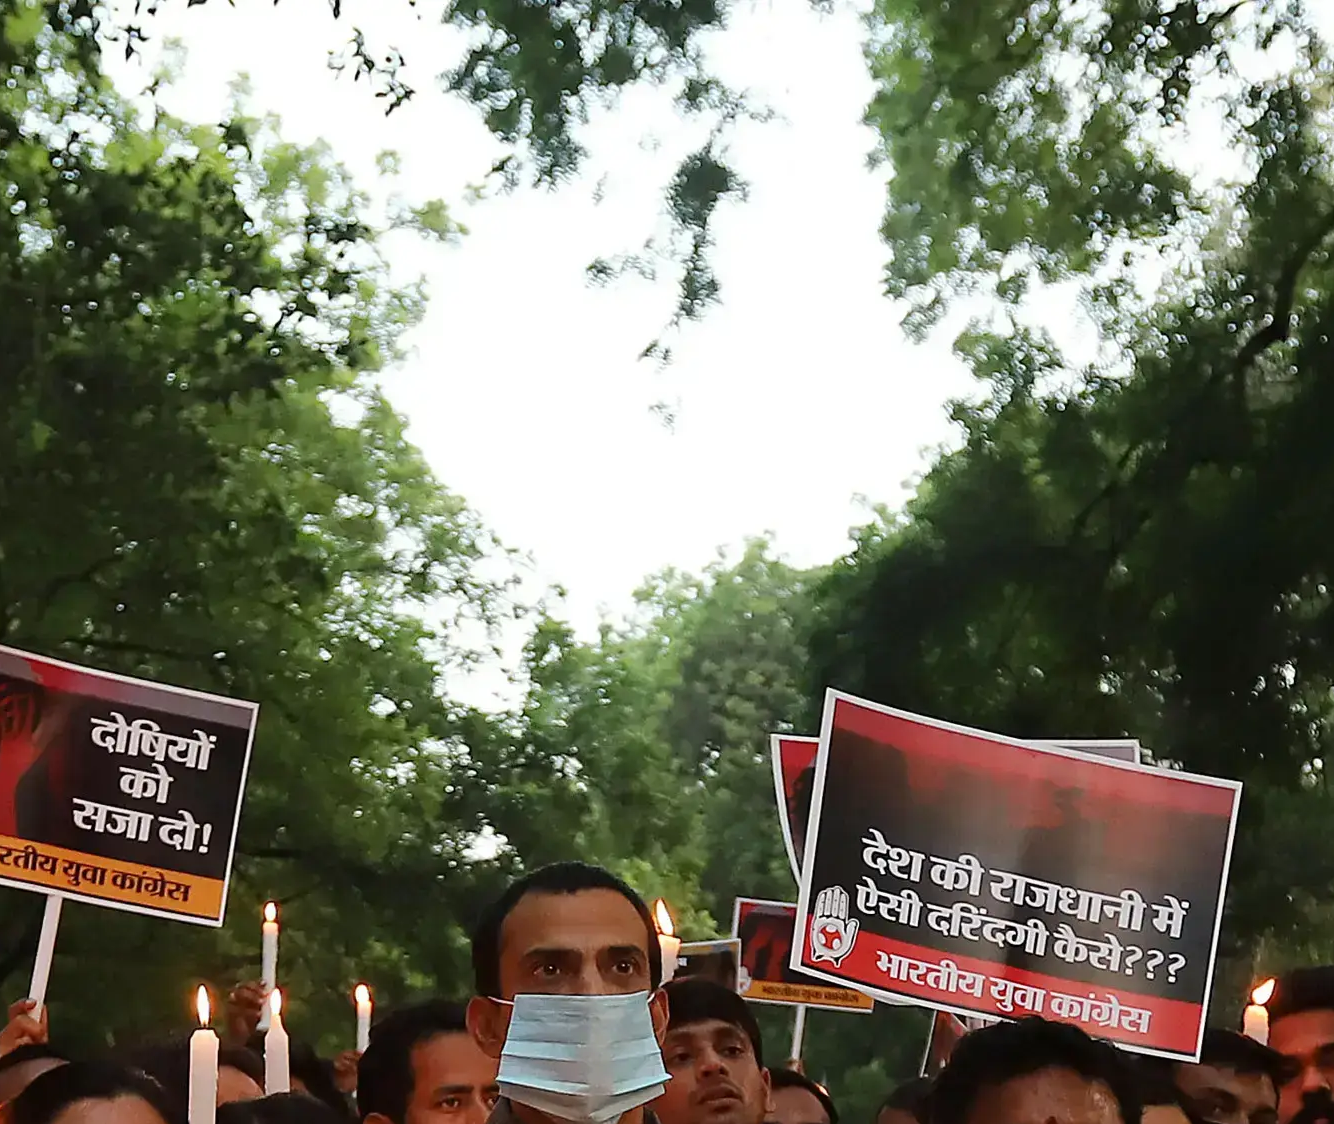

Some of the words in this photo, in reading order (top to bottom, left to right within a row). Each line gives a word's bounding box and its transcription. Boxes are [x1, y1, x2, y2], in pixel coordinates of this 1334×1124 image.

[90, 712, 217, 770] दोषियों
[118, 763, 174, 804] को
[72, 798, 154, 841] सजा
[158, 810, 213, 854] दो!
[62, 859, 107, 887] युवा
[112, 871, 191, 902] कांग्रेस
[861, 828, 926, 882] देश
[930, 853, 985, 896] की
[989, 869, 1147, 932] राजधानी
[1151, 895, 1190, 938] में
[856, 876, 922, 927] ऐसी
[927, 902, 1050, 957] दरिंदगी
[1053, 923, 1186, 983] कैसे???
[876, 950, 985, 998] भारतीय
[990, 976, 1045, 1013] युवा
[1051, 992, 1151, 1034] कांग्रेस
